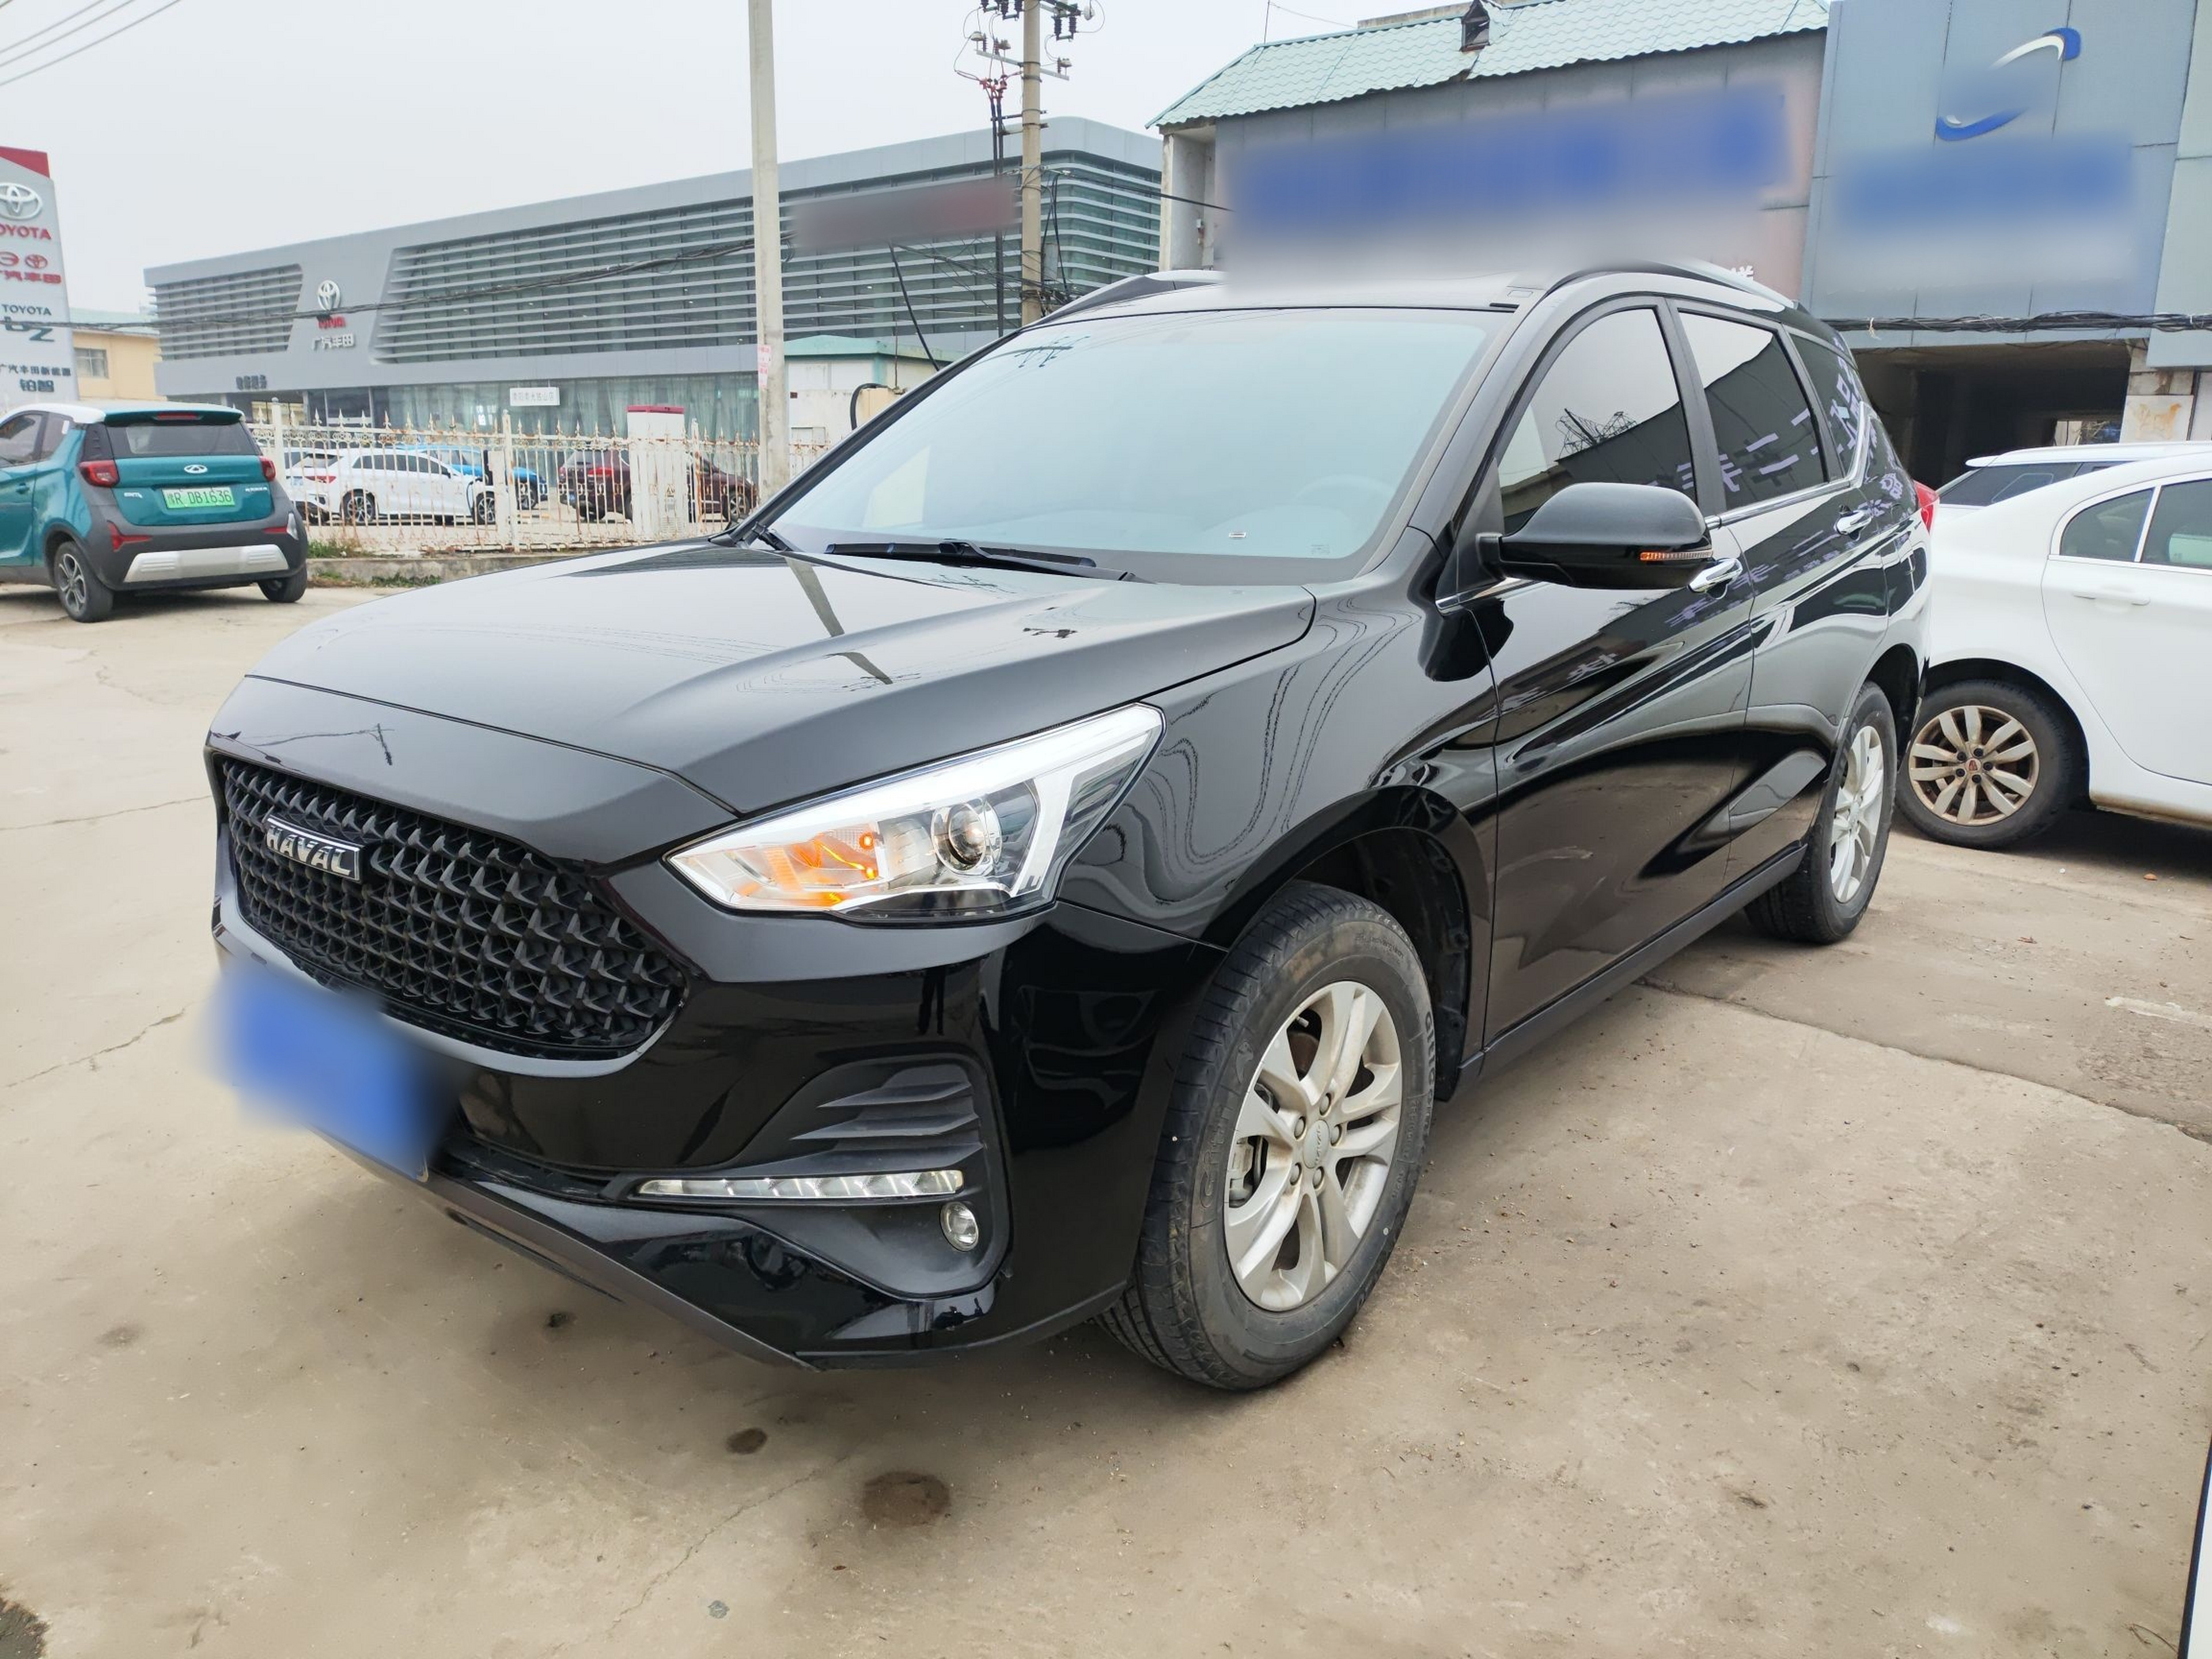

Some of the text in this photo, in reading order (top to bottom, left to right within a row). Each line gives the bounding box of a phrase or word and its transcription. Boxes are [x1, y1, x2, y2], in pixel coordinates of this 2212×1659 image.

[0, 270, 62, 284] 汽丰田
[2, 304, 52, 316] TOYOTA
[188, 490, 232, 505] DB1636
[267, 825, 352, 876] HAVAL
